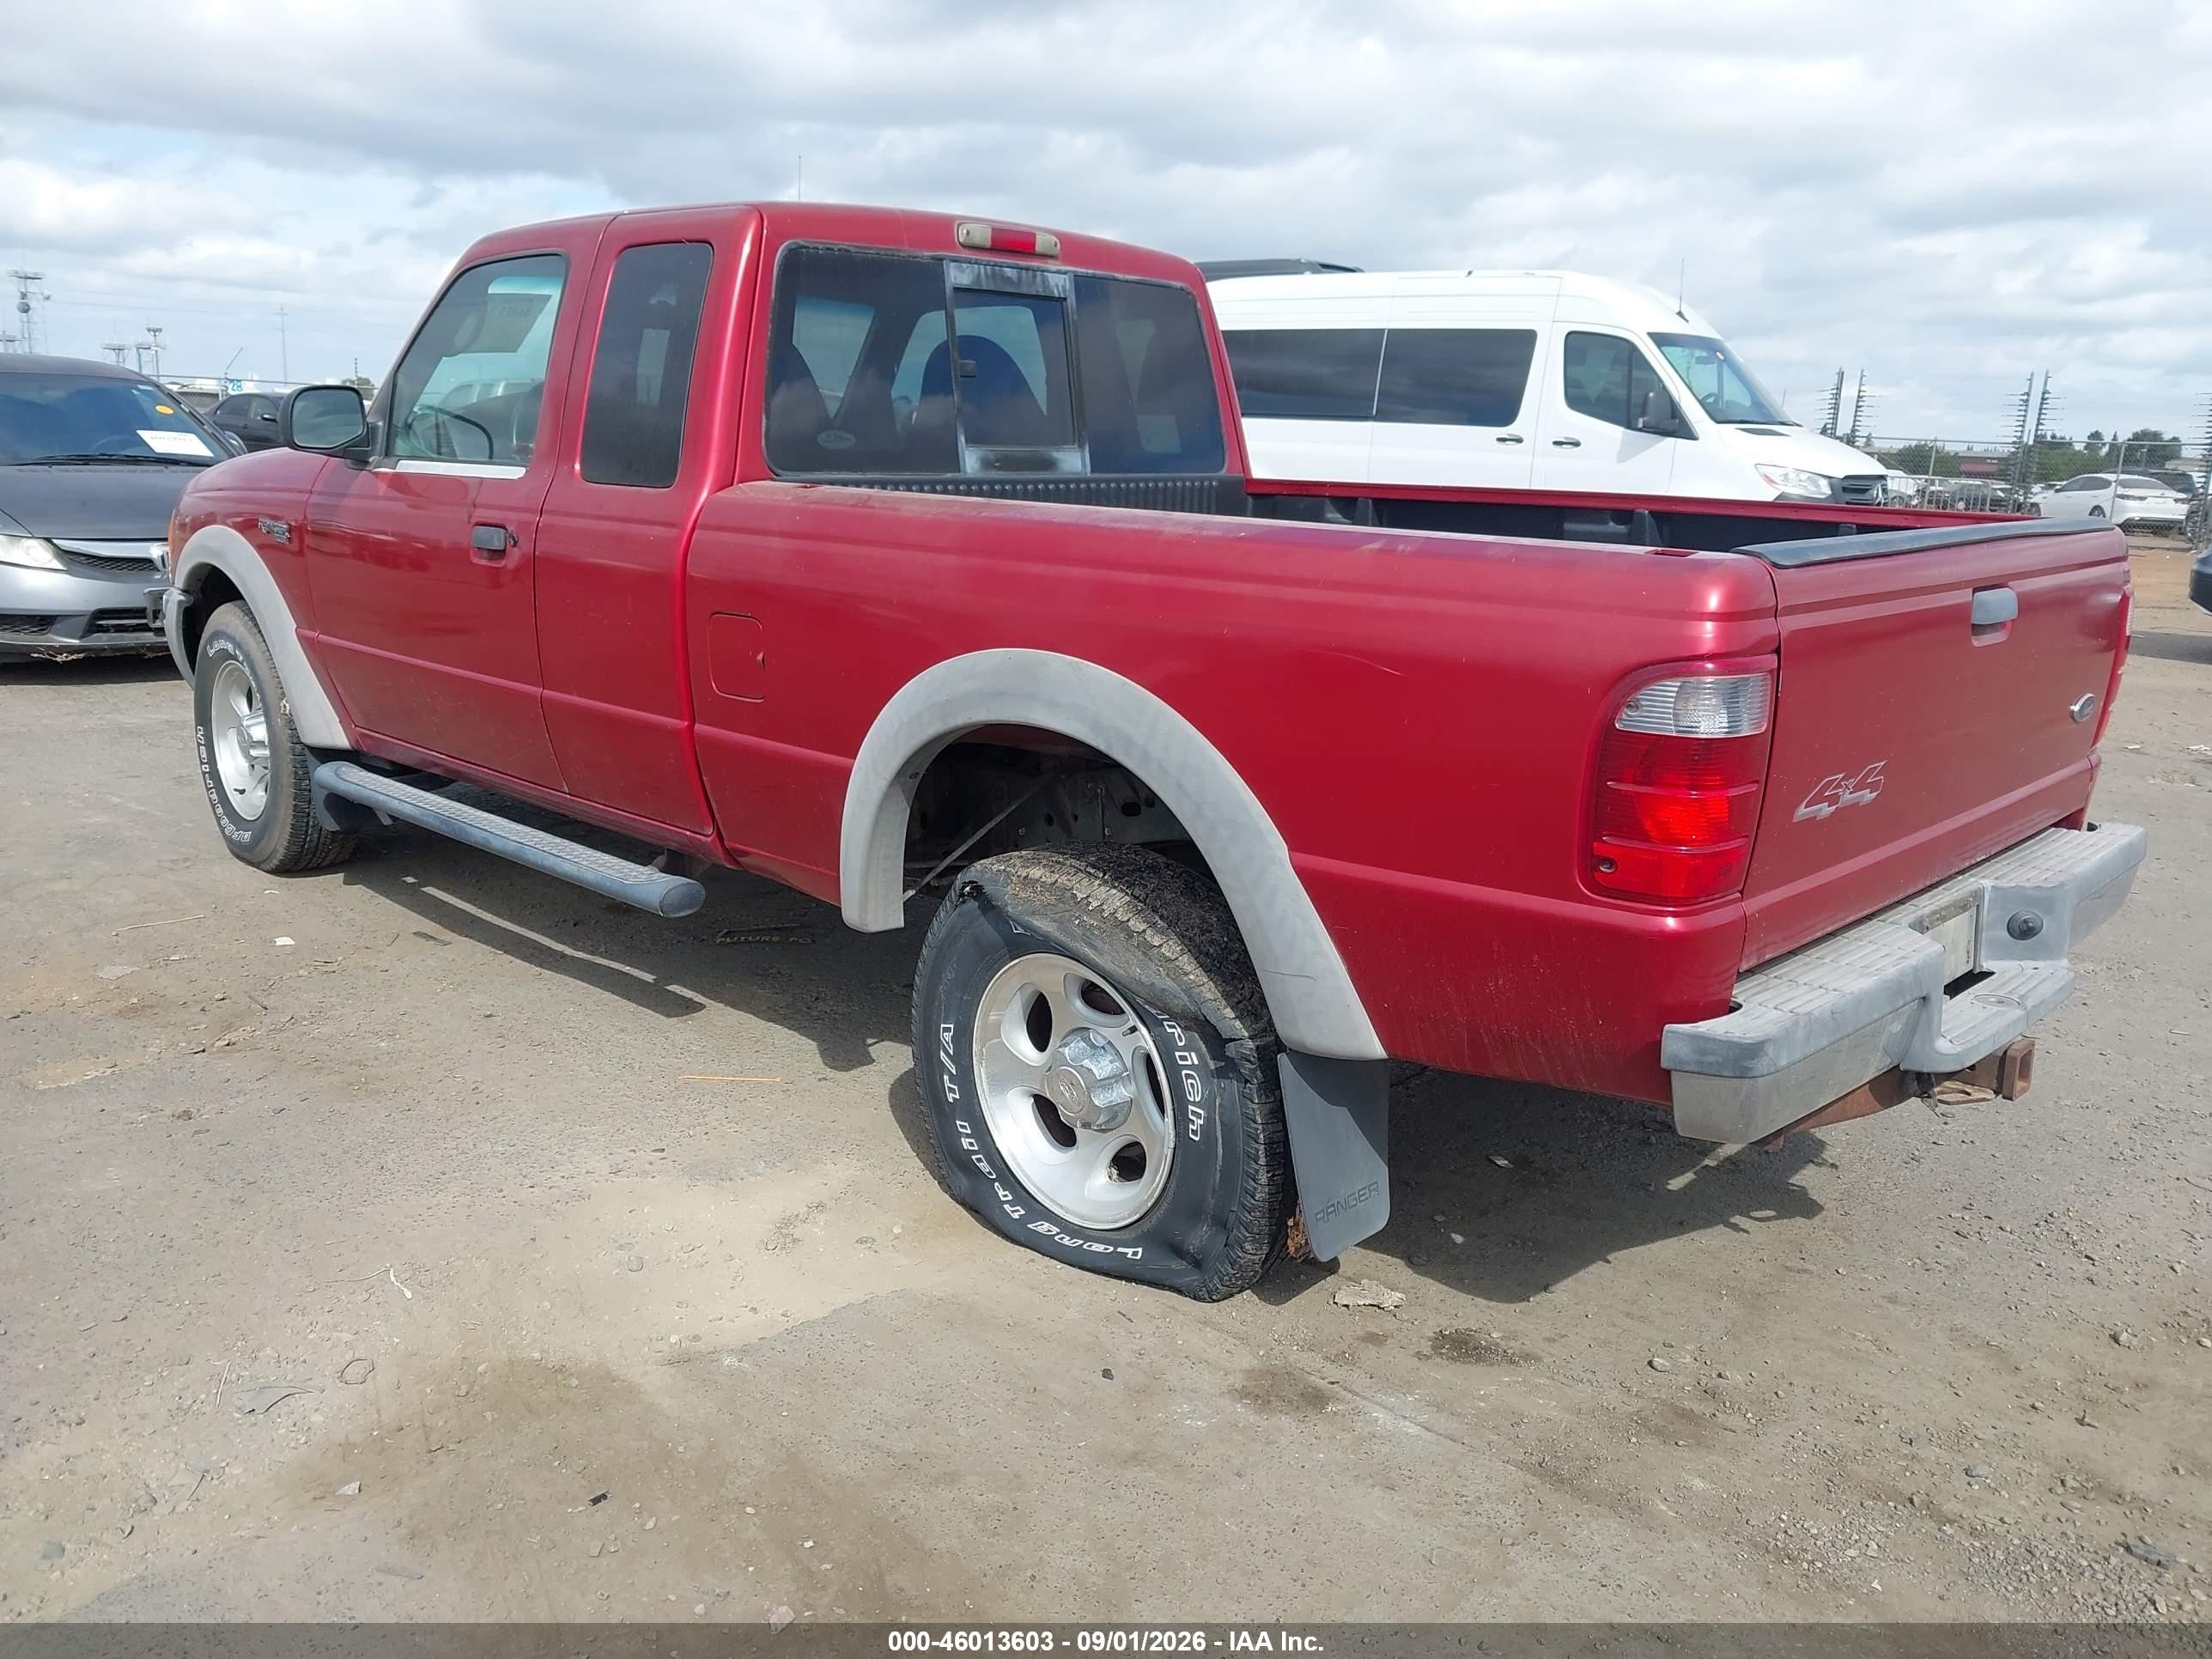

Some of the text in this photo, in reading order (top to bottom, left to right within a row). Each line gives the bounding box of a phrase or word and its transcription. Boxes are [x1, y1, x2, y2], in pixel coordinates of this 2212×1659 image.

[940, 1023, 1143, 1260] Long Trail T/A
[1314, 1181, 1381, 1224] RANGER
